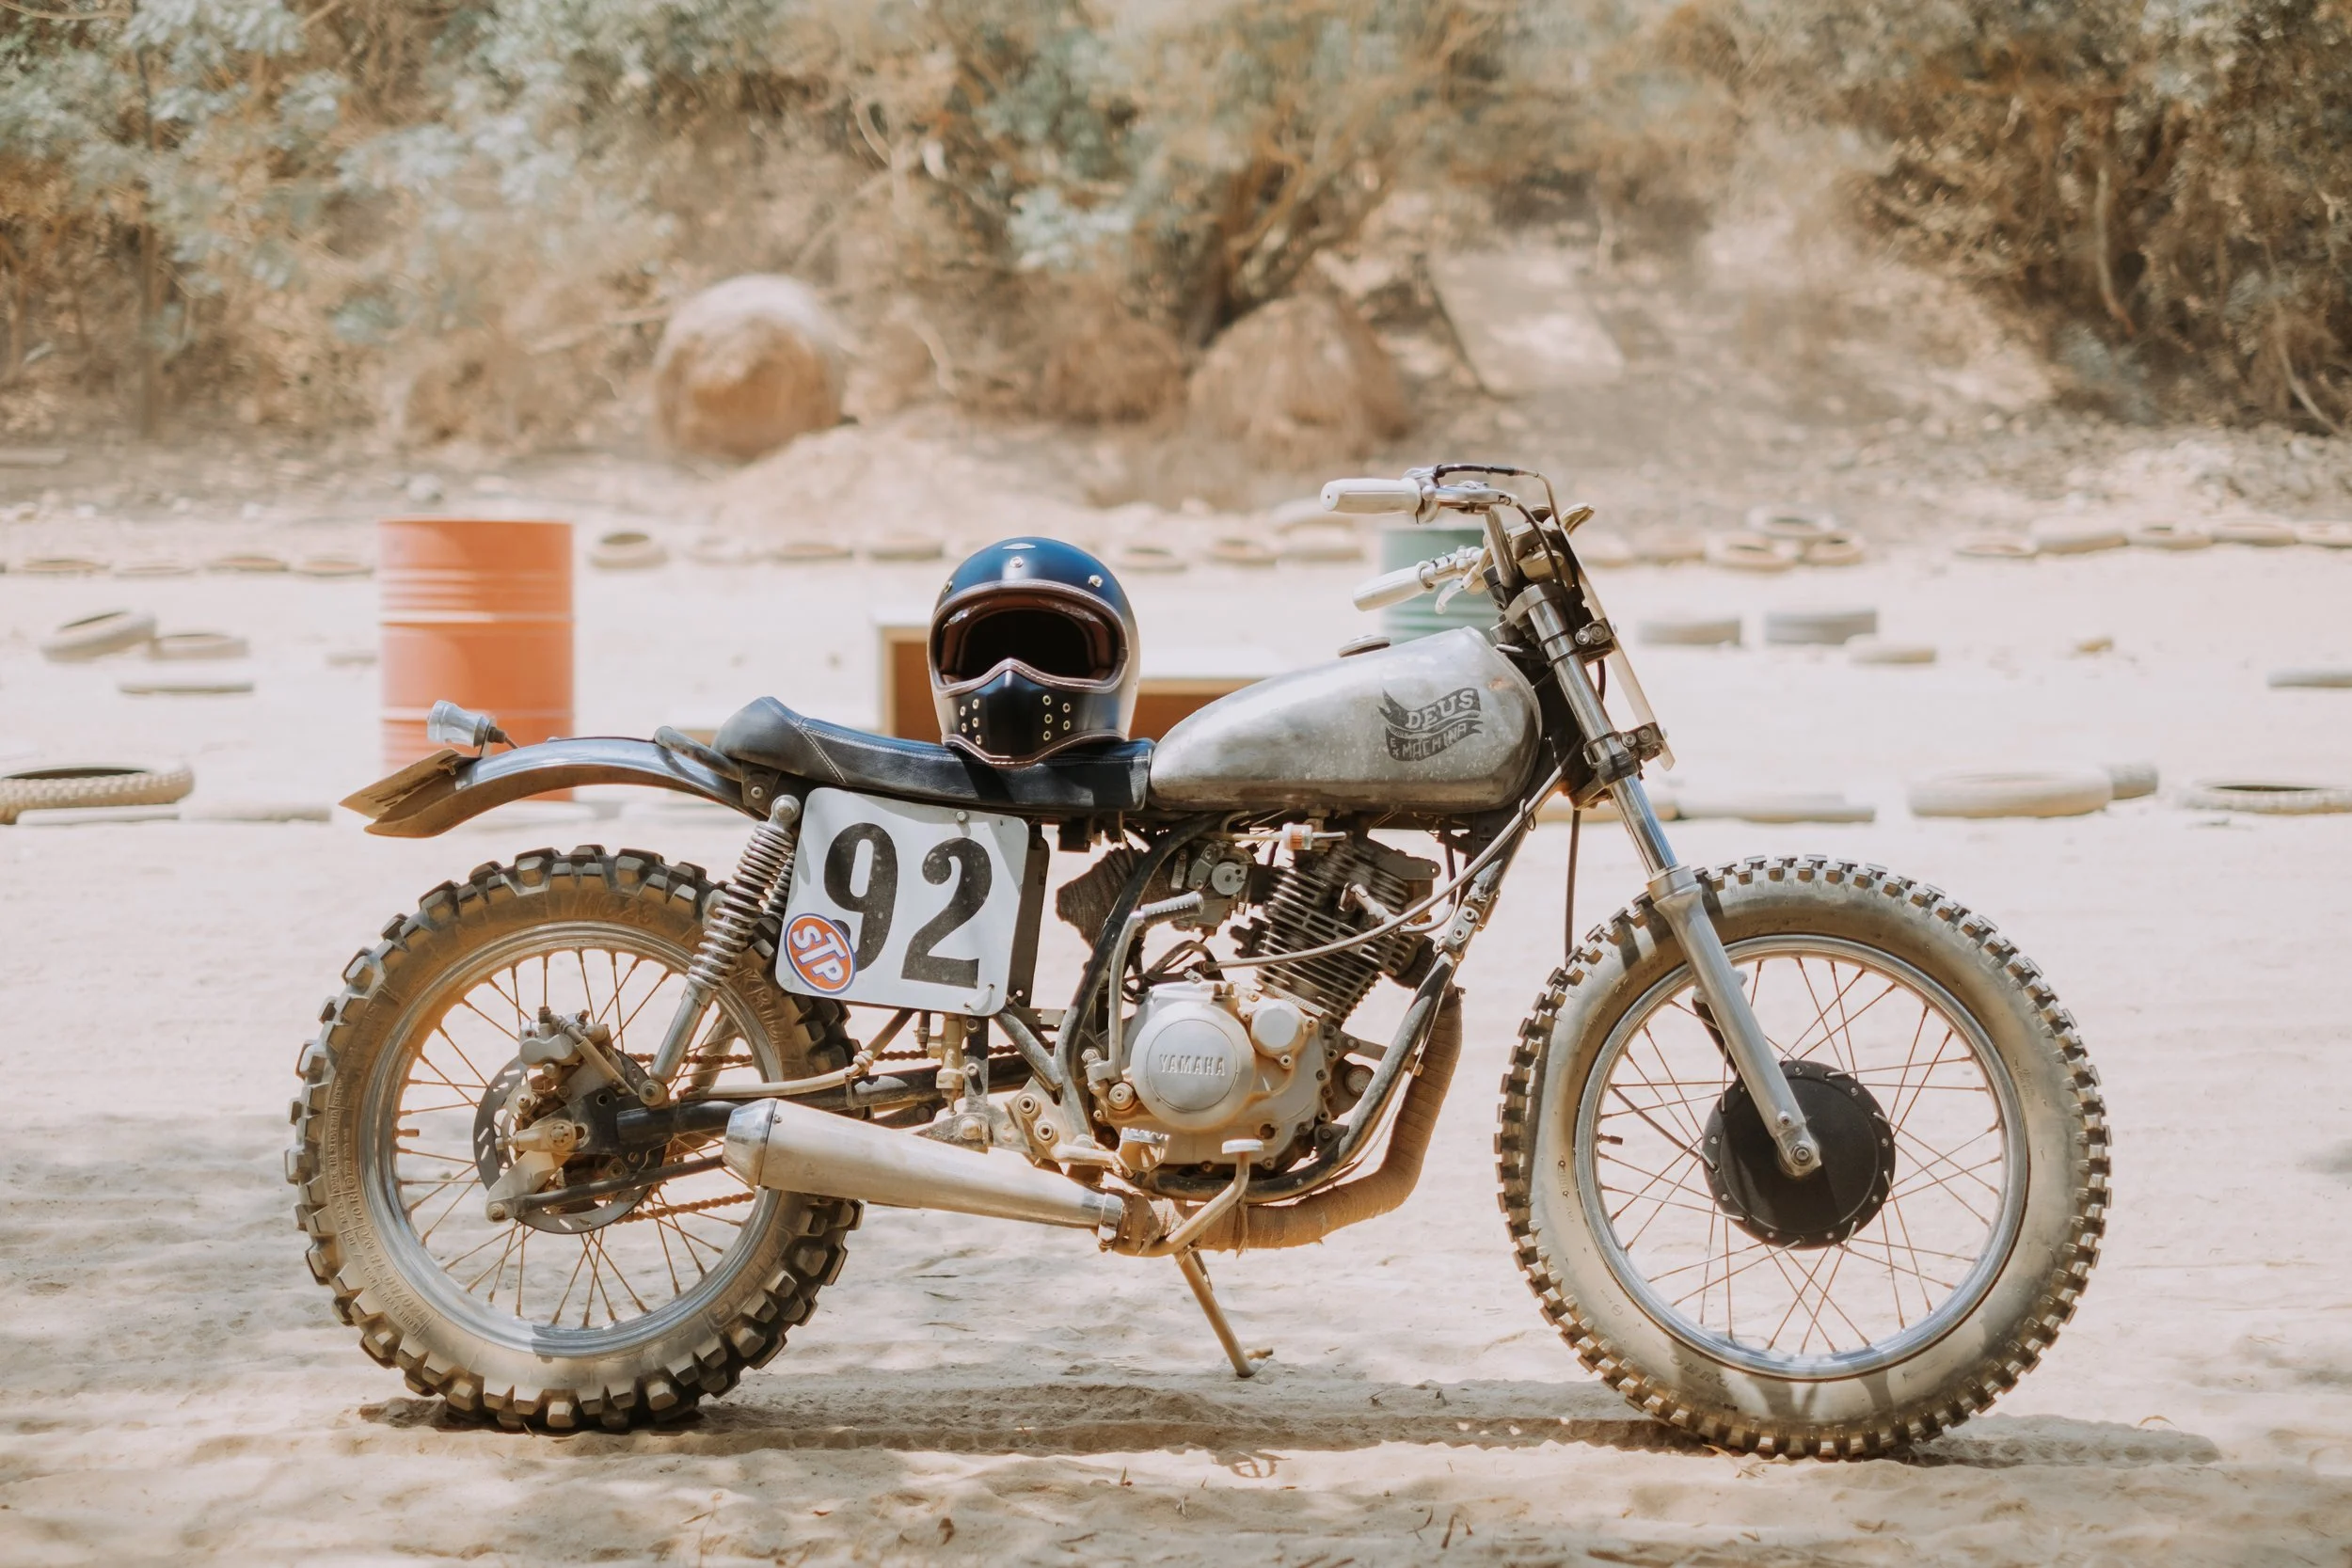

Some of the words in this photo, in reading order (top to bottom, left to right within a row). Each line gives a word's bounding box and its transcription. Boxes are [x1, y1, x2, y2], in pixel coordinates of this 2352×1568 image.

[1405, 689, 1474, 729] DEUS
[1402, 722, 1467, 758] MACHINA
[824, 822, 993, 989] 92
[791, 925, 847, 984] STP
[1158, 1053, 1226, 1076] YAMAHA
